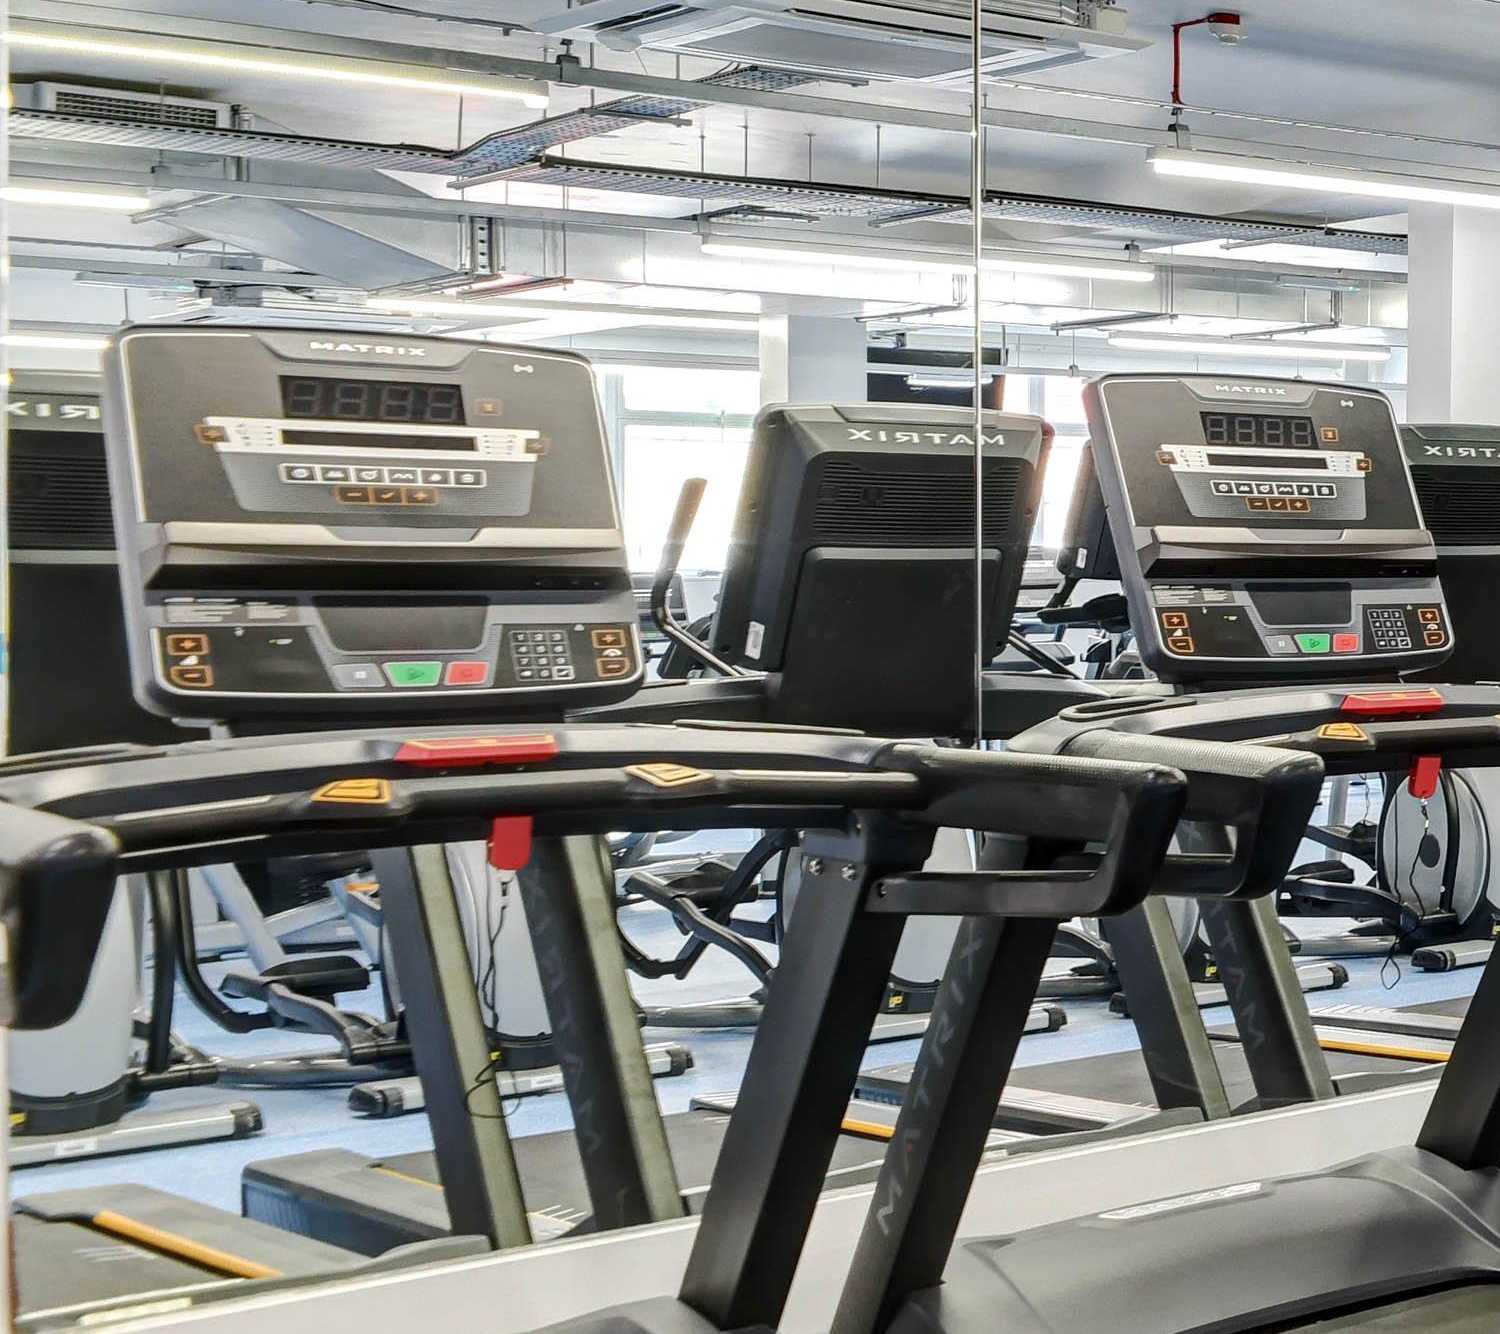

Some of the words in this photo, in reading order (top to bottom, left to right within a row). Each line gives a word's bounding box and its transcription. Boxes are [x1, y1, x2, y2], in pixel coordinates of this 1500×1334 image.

[310, 341, 426, 356] MATRIX
[1215, 384, 1286, 395] MATRIX
[876, 919, 984, 1236] MATRIX
